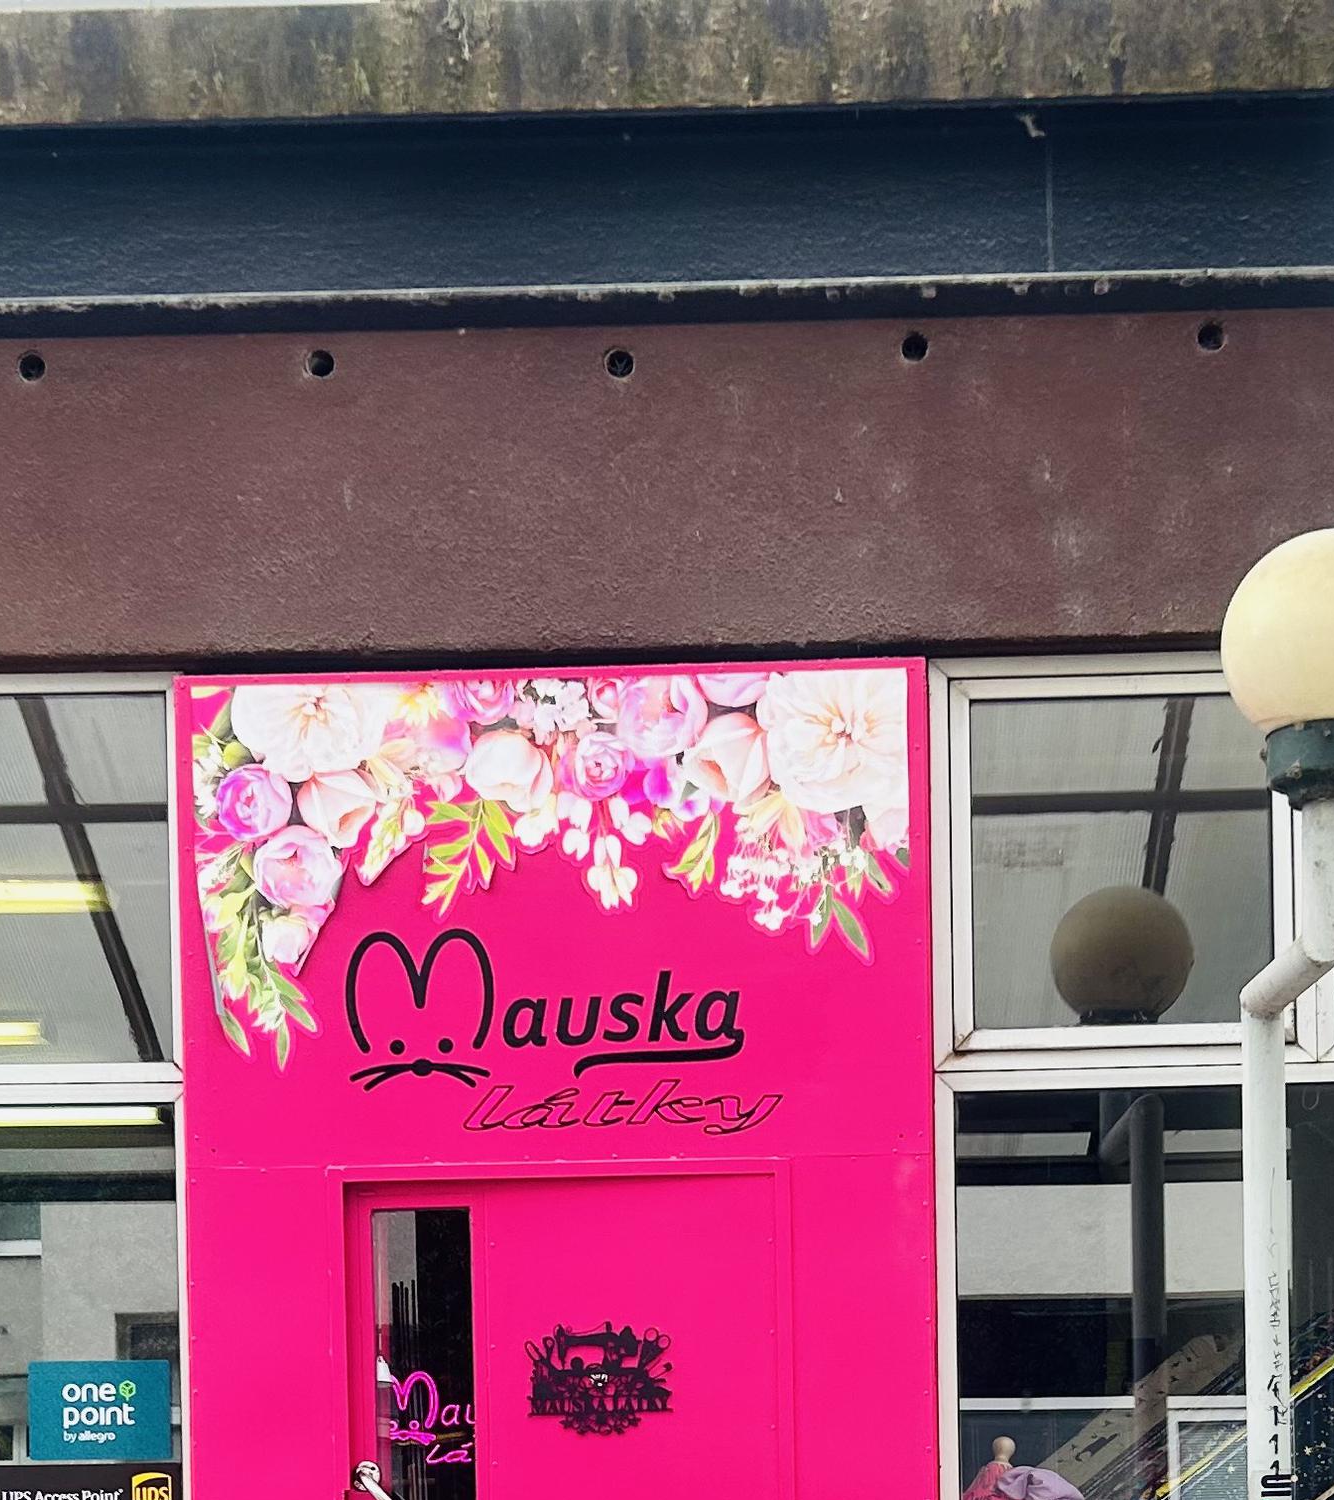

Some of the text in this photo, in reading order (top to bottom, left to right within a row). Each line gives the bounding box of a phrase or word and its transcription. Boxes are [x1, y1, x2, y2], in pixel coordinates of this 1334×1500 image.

[346, 928, 744, 1078] Mauska
[463, 1078, 784, 1136] látky
[62, 1383, 116, 1403] one
[62, 1403, 135, 1429] point
[63, 1430, 116, 1444] by allegro
